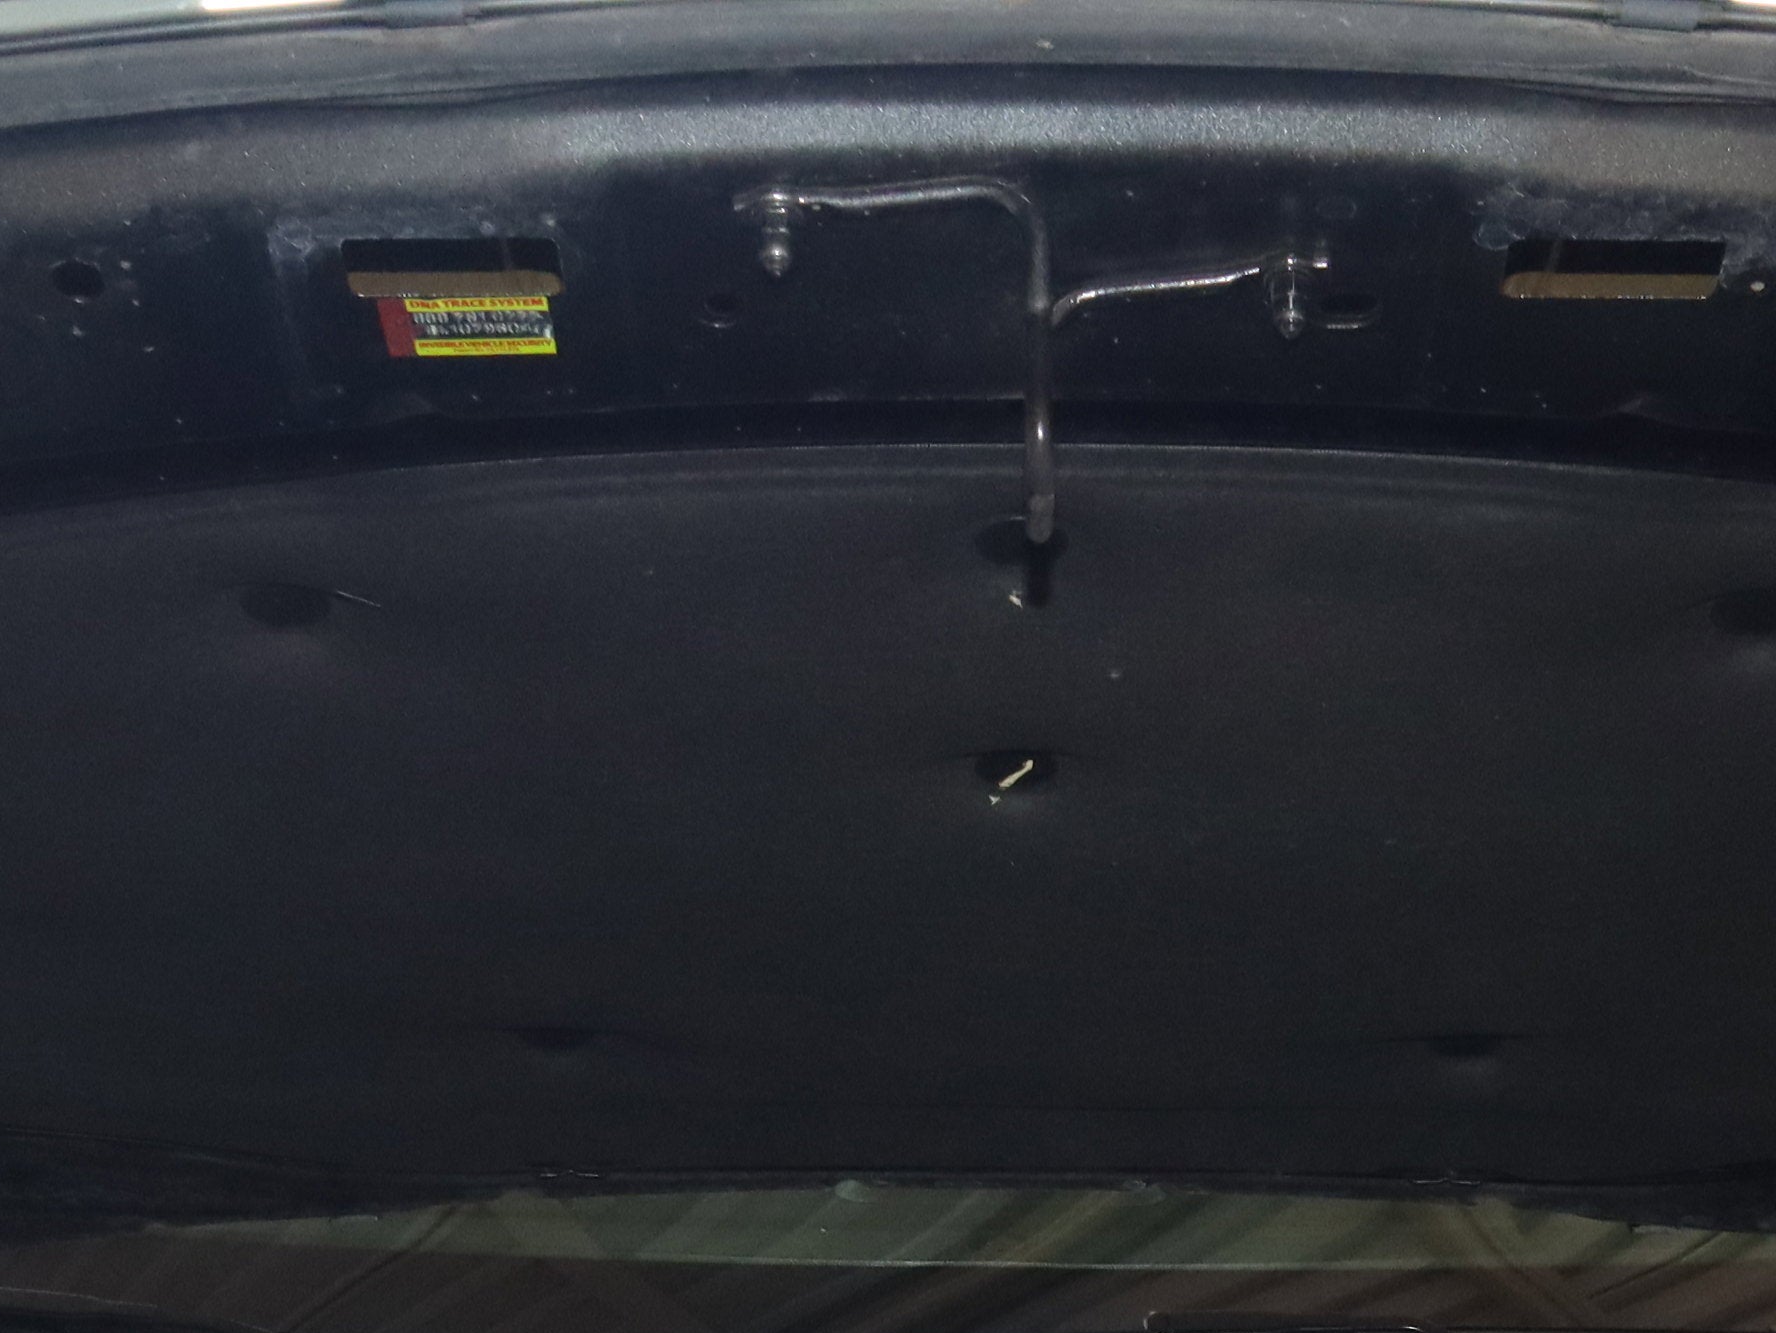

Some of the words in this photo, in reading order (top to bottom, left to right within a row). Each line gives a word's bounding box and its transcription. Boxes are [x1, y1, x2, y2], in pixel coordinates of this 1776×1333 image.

[410, 300, 439, 309] DNA
[442, 298, 485, 307] TRACE
[488, 297, 544, 307] SYSTEM
